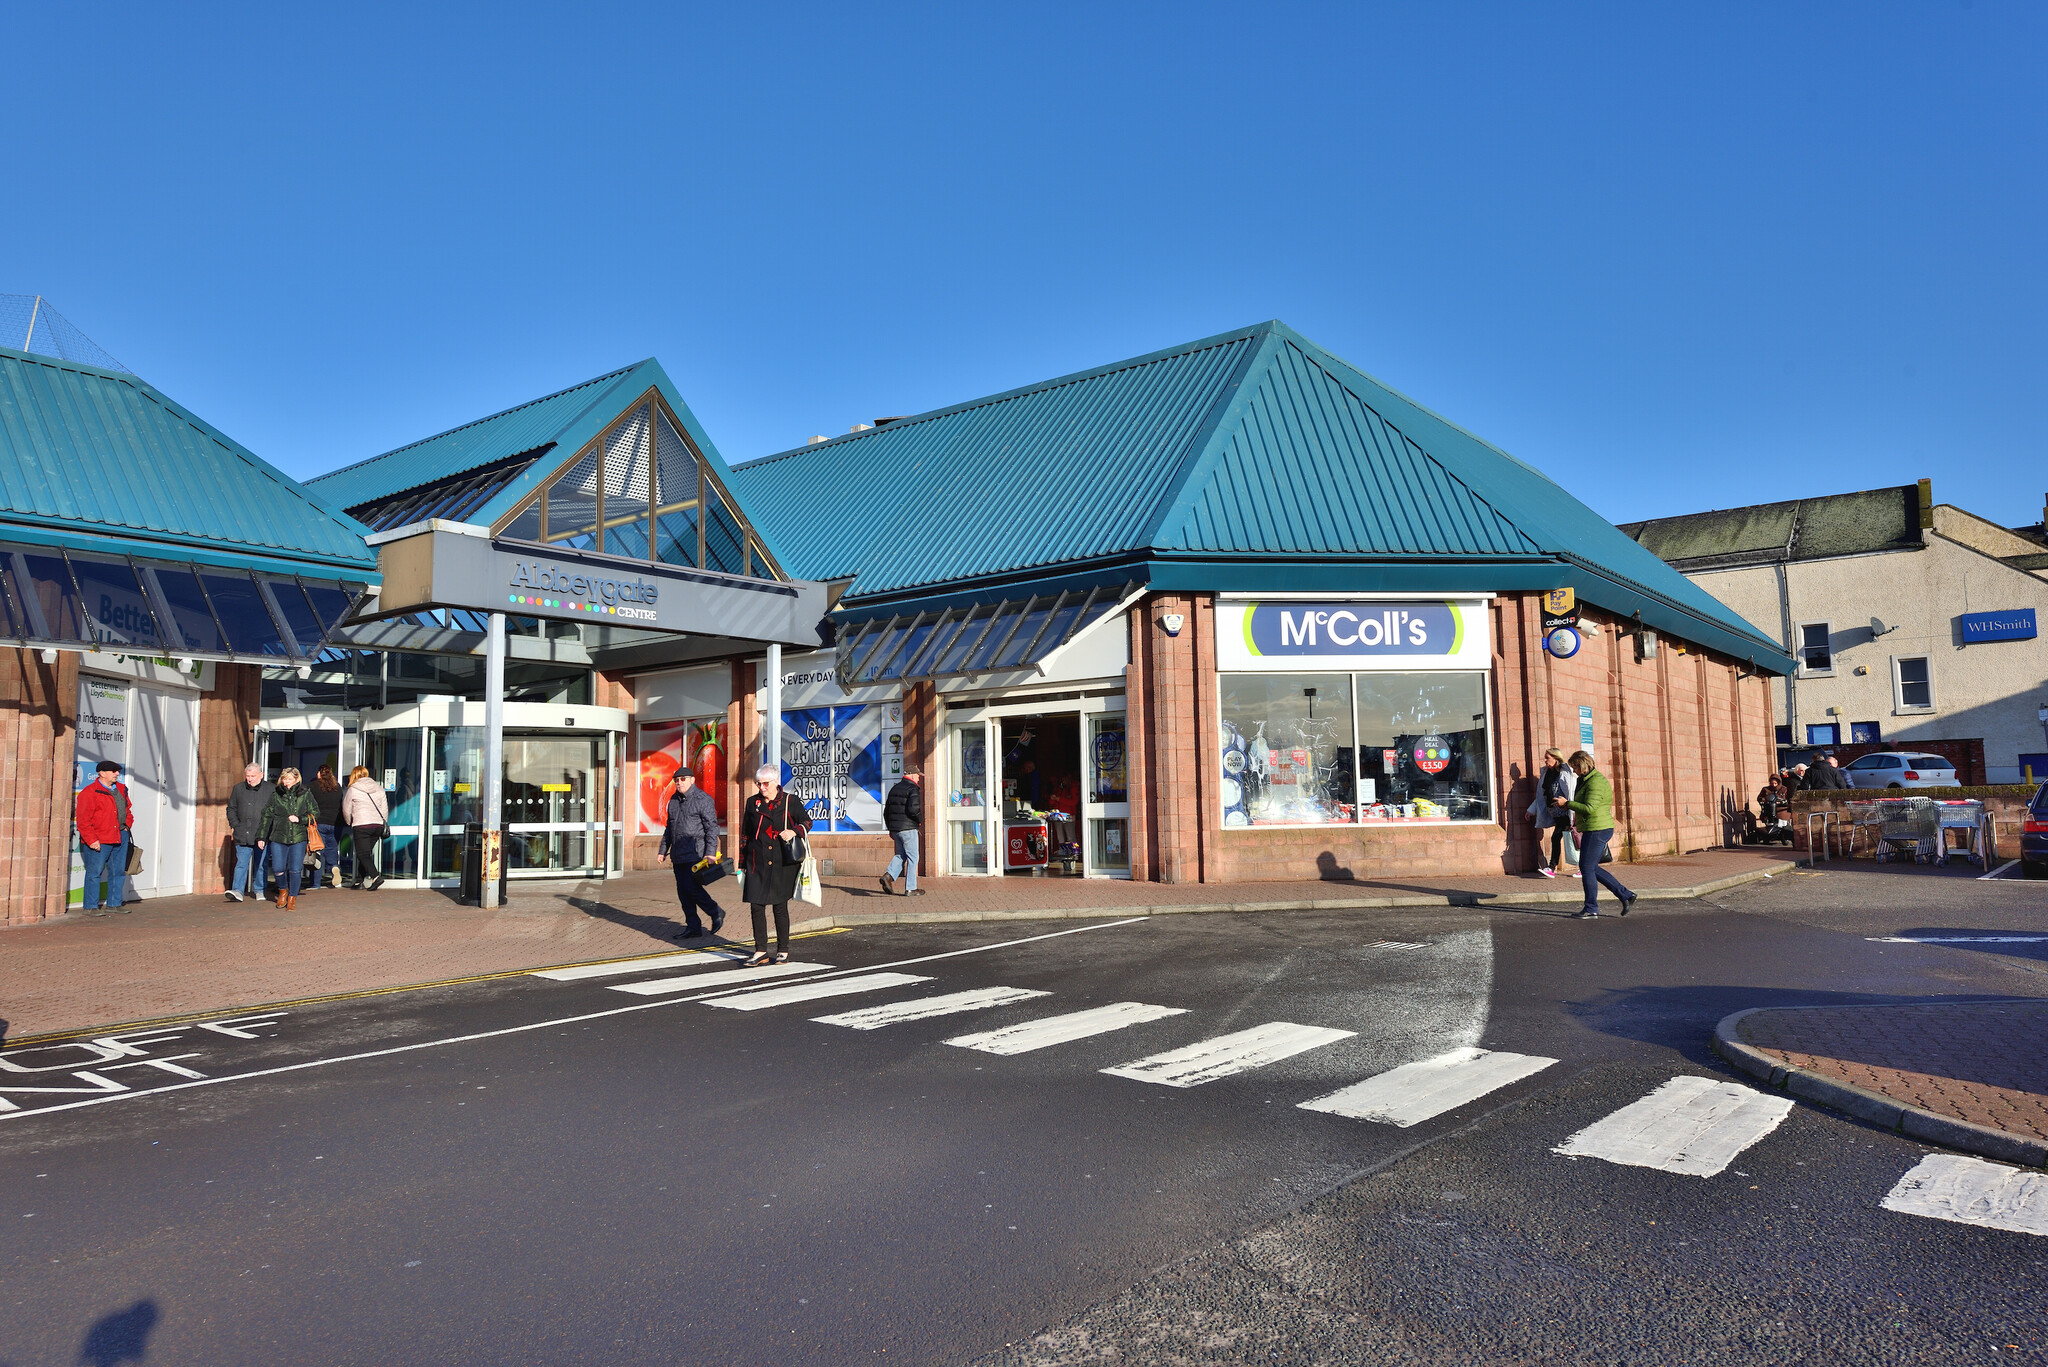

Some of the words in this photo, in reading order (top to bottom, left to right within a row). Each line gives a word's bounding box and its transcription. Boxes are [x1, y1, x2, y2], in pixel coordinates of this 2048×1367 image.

[510, 560, 659, 606] Abbeygate
[617, 606, 657, 620] CENTRE
[1280, 610, 1427, 646] McColl's
[1968, 618, 2031, 632] WHSmith
[788, 672, 815, 685] EVERY
[817, 671, 834, 682] DAY
[83, 711, 124, 727] independent
[86, 731, 91, 739] a
[92, 729, 112, 741] better
[114, 730, 124, 742] life
[790, 741, 810, 764] 115
[810, 738, 851, 763] YEARS
[792, 766, 803, 776] OF
[1422, 761, 1442, 769] £3.50
[794, 776, 848, 800] SERVING
[801, 799, 847, 820] otlad
